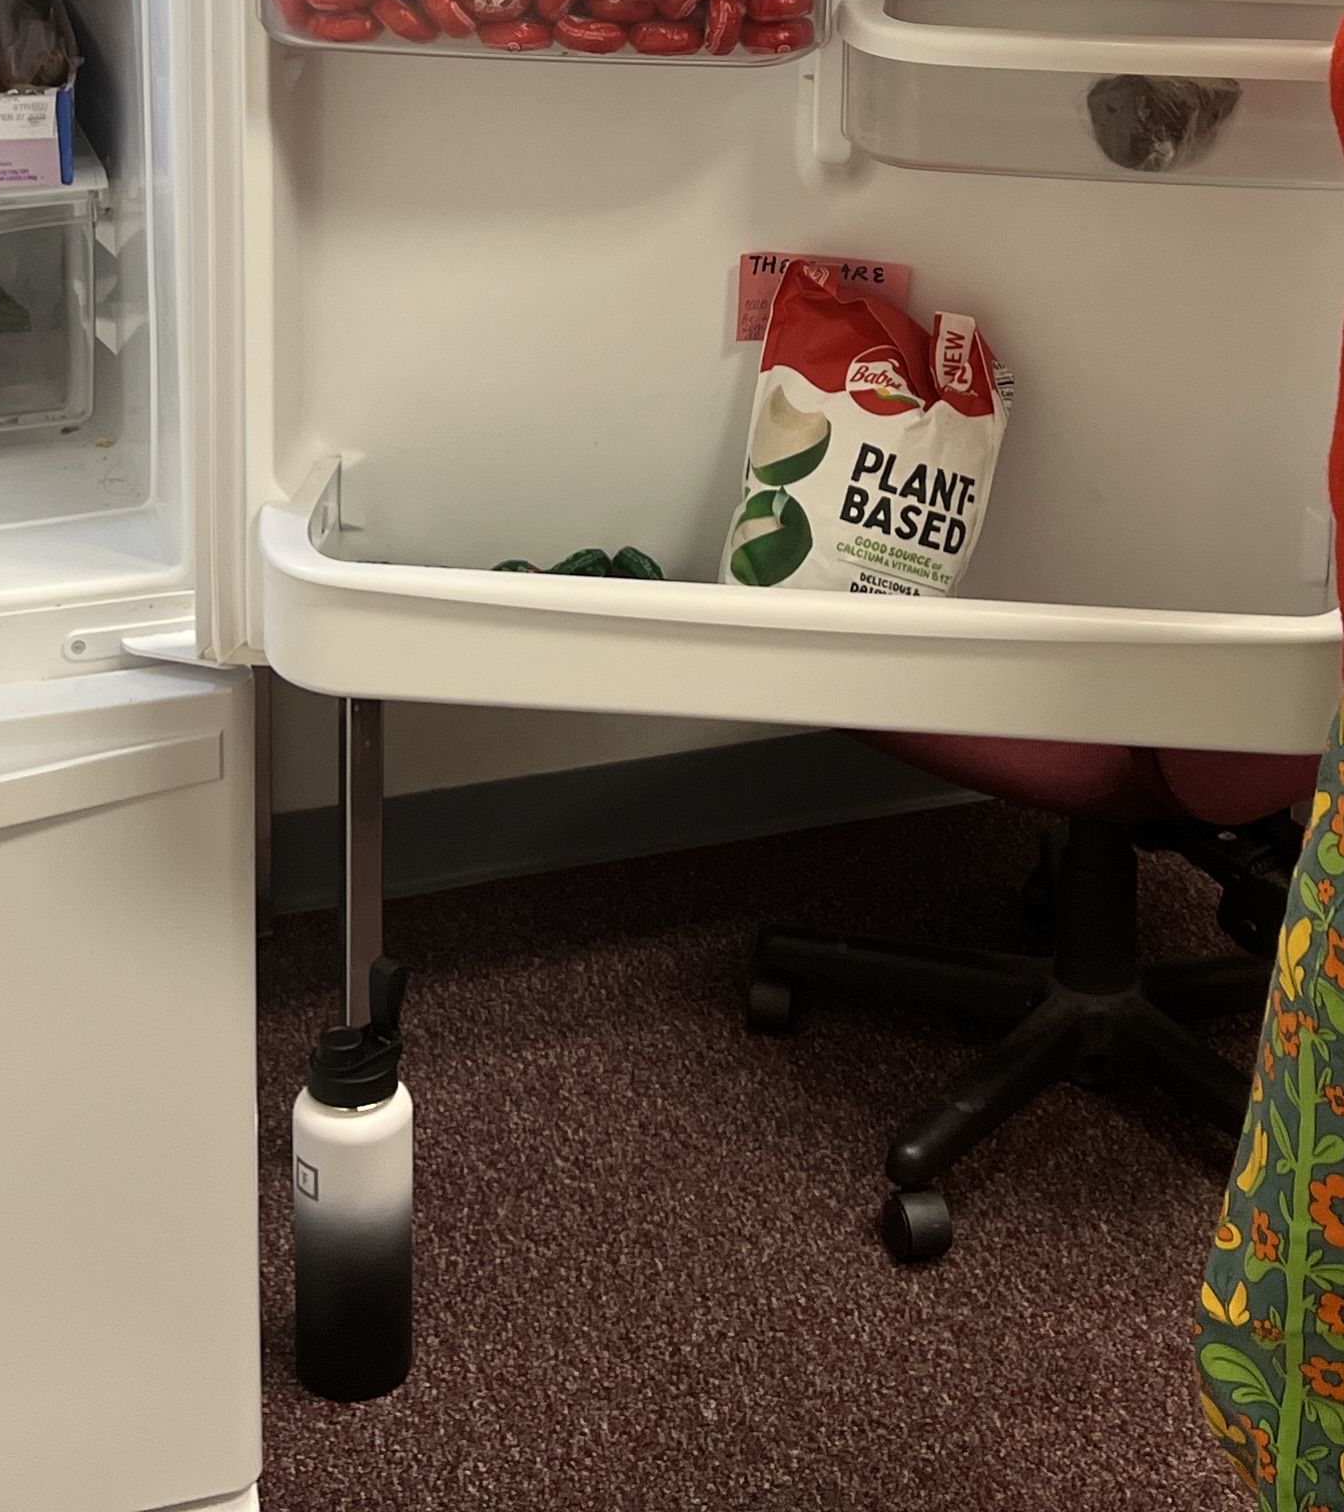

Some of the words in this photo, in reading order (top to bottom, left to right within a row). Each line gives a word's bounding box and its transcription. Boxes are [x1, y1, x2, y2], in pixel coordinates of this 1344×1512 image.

[841, 263, 885, 283] ARE
[943, 330, 966, 381] NEW
[851, 442, 976, 515] PLANT-
[839, 484, 966, 555] BASED
[836, 542, 884, 565] CALCIUM
[891, 560, 930, 579] VITAMIN
[855, 536, 888, 554] GOOD
[888, 546, 932, 567] SOURCE
[932, 562, 943, 570] OF
[859, 572, 912, 594] DELICIOUS
